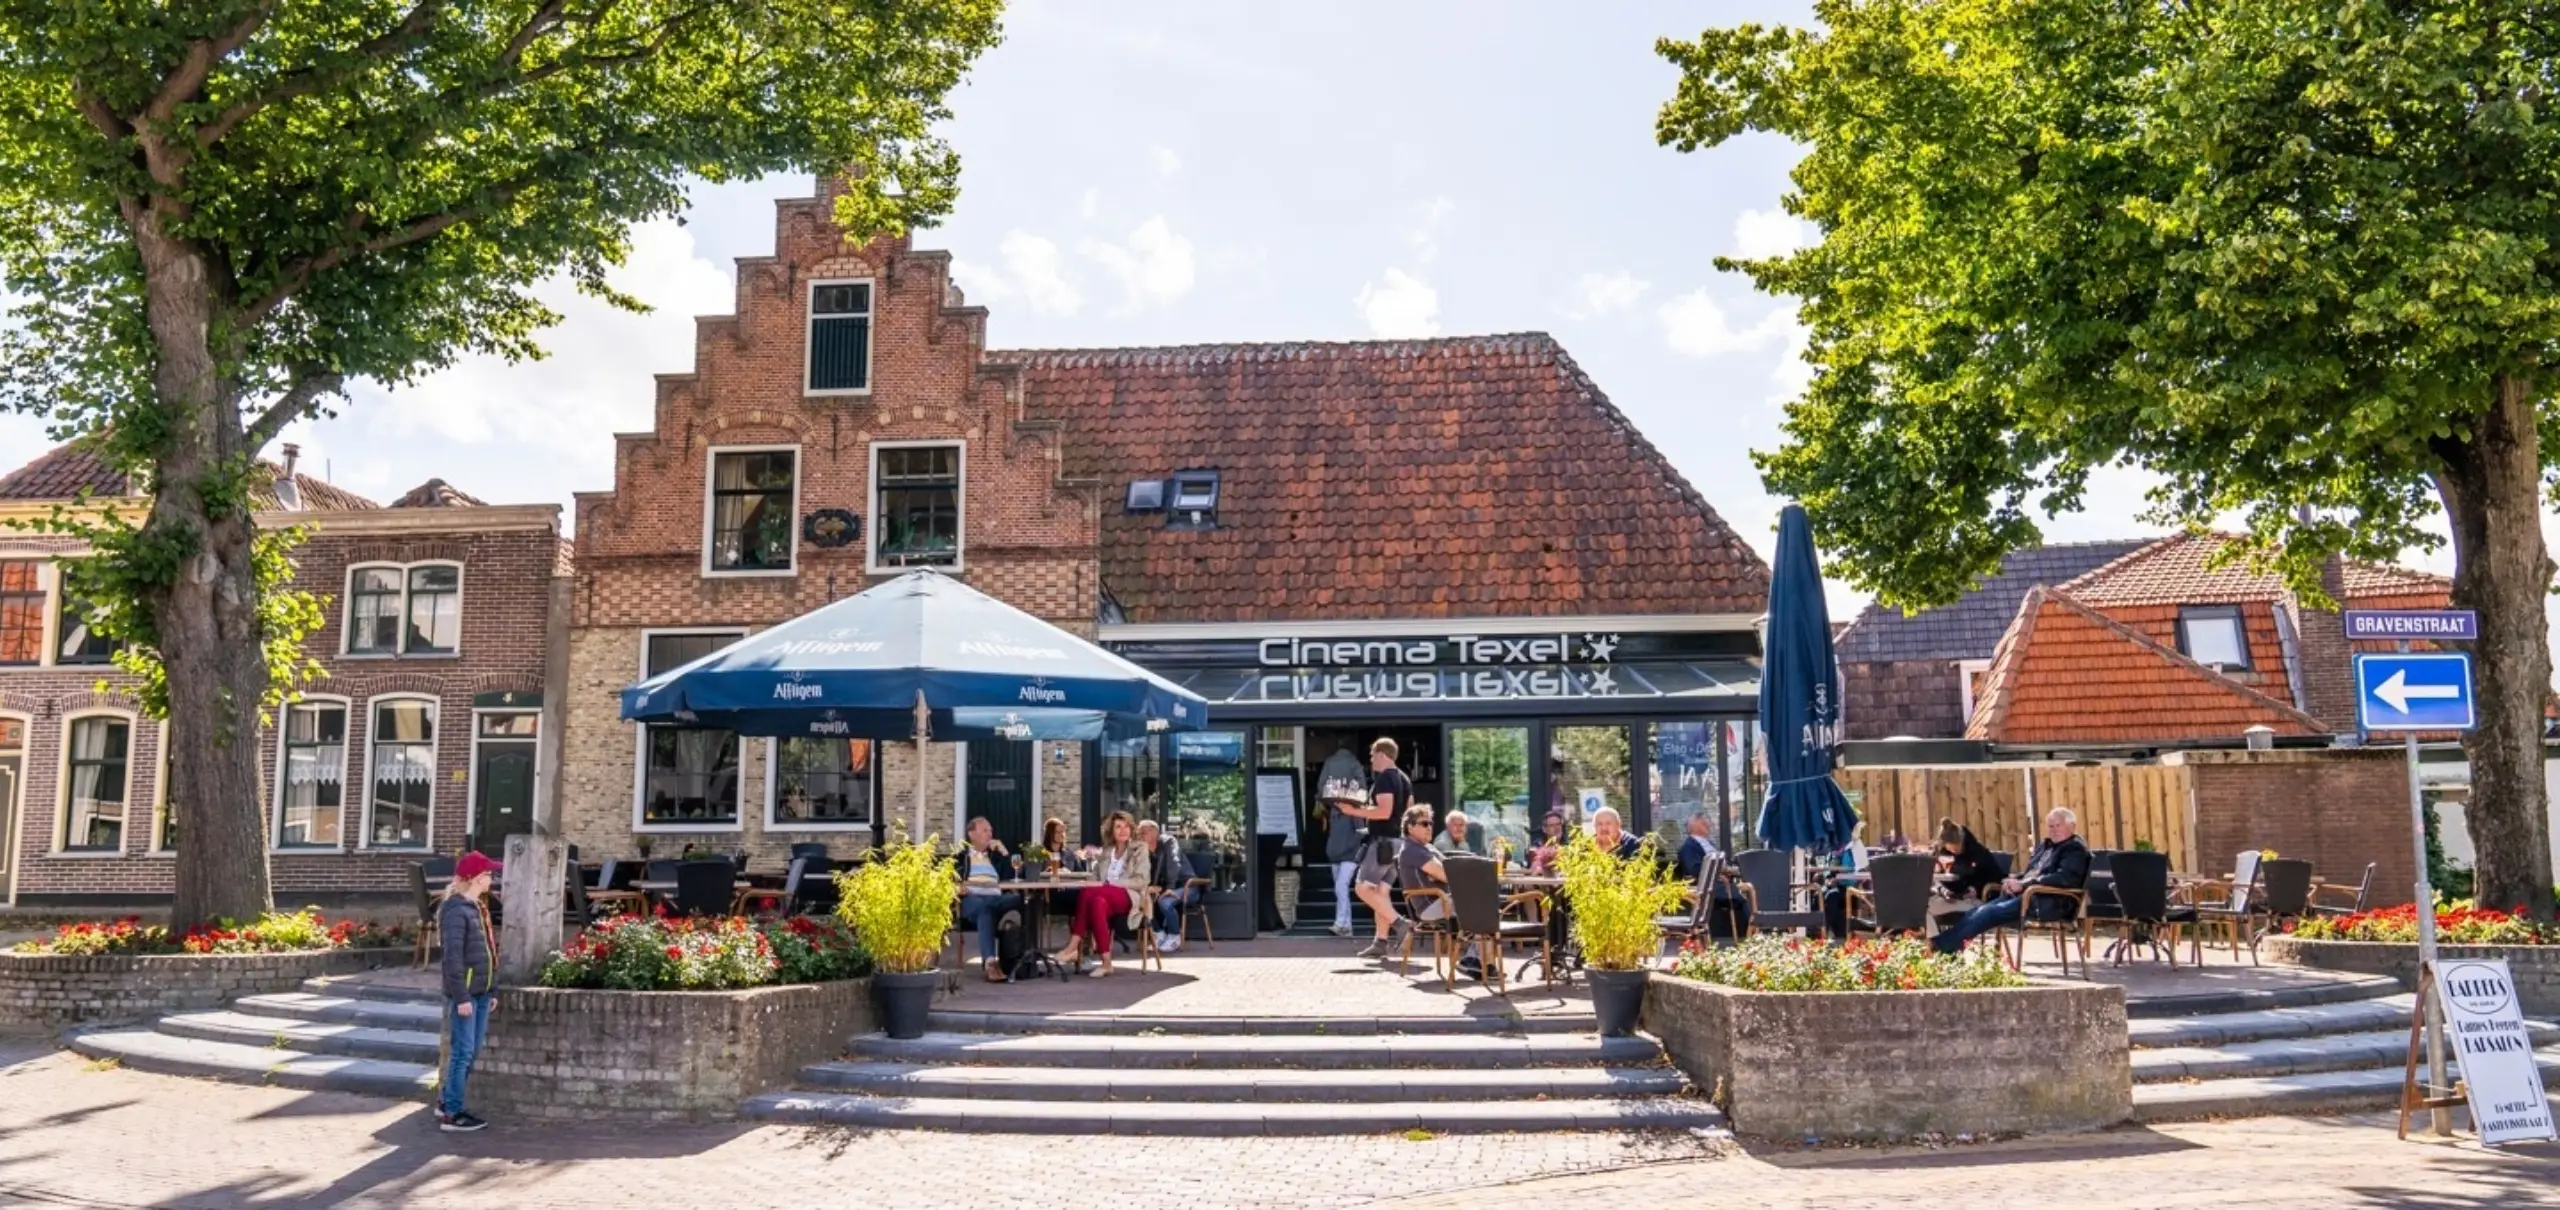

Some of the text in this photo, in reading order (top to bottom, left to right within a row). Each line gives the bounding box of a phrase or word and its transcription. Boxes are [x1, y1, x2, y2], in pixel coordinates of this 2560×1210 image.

[2355, 617, 2466, 633] GRAVENSTRAAT
[1258, 633, 1570, 666] Cinema Texel
[773, 683, 823, 701] Affligem
[1018, 686, 1066, 703] Affligem
